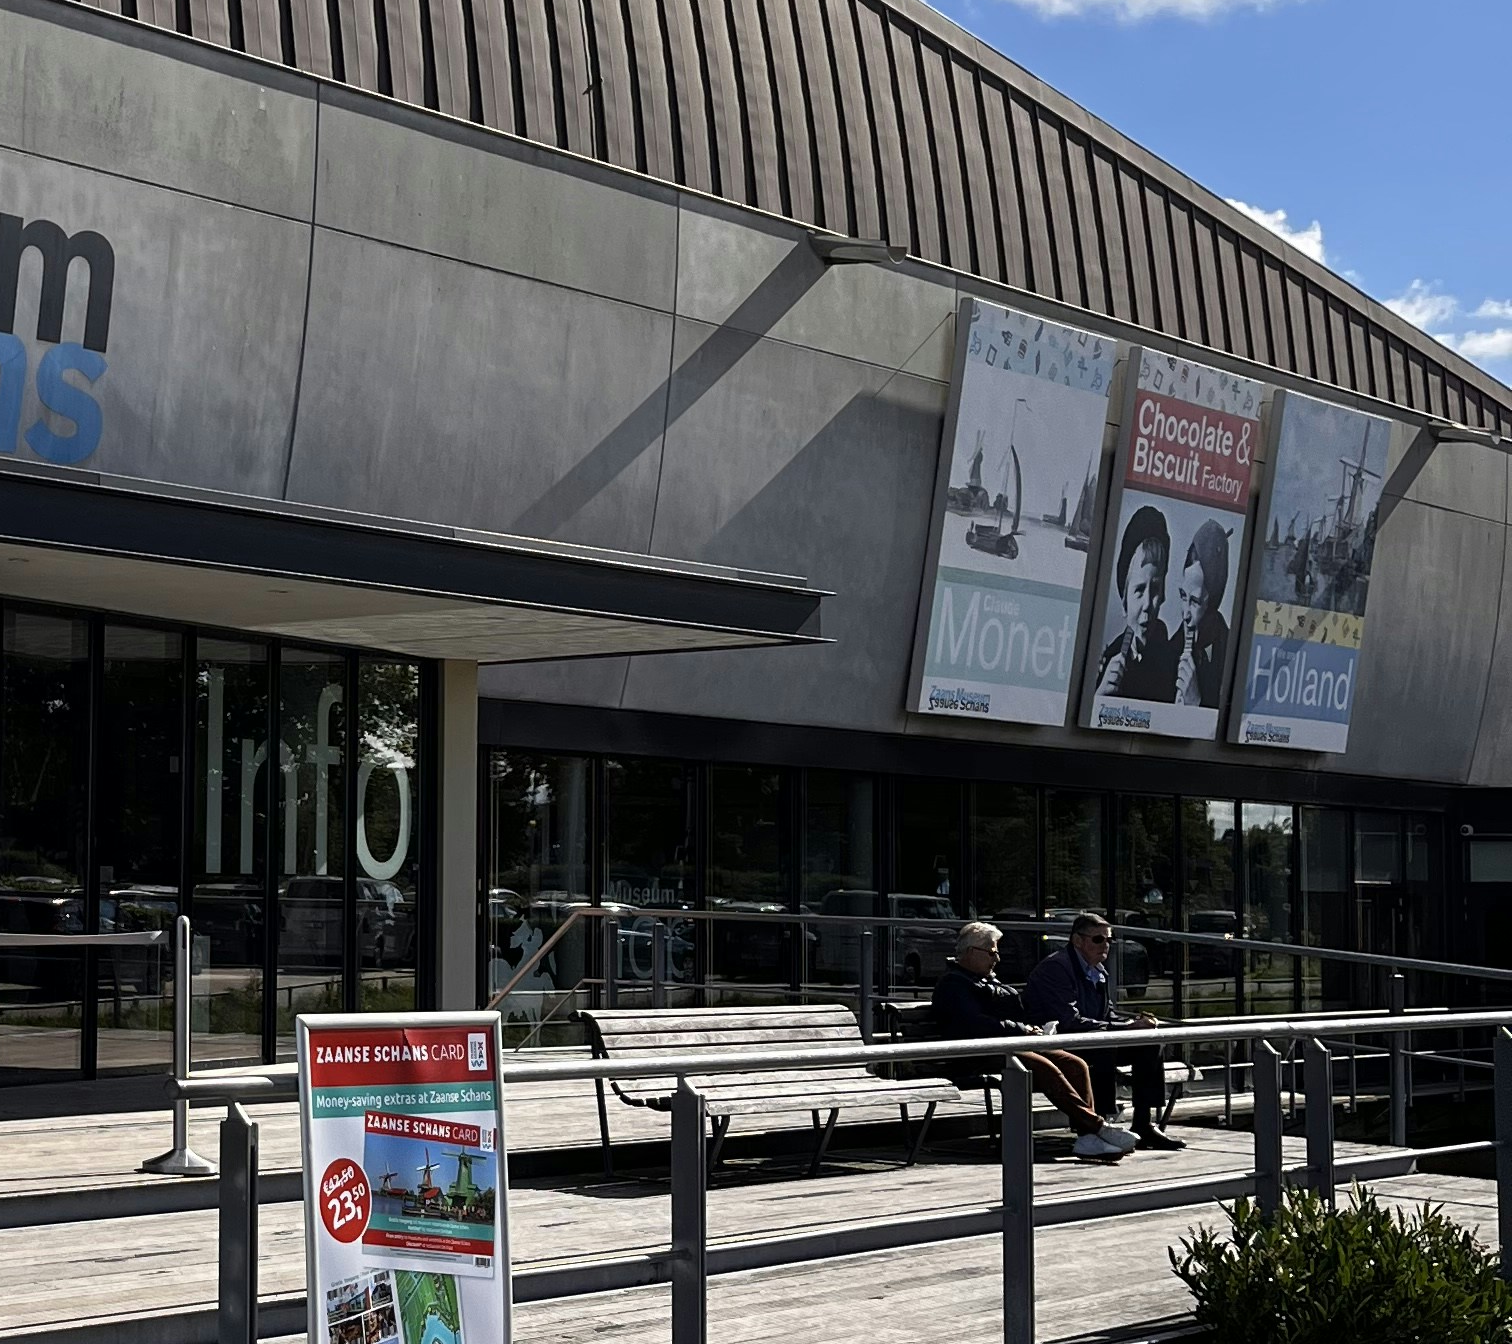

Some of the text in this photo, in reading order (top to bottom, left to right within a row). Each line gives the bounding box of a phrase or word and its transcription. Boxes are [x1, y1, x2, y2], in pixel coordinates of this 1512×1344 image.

[1139, 399, 1251, 467] Chocolate &
[1133, 437, 1244, 502] Biscuit Factory
[934, 587, 1071, 680] Monet
[1250, 645, 1354, 711] Holland
[205, 668, 412, 881] Info
[316, 1046, 370, 1064] ZAANSE
[374, 1044, 429, 1062] SCHANS
[431, 1044, 465, 1061] CARD
[316, 1088, 492, 1110] Money-saving extras at Zaanse Schans
[367, 1114, 410, 1133] ZAANSE
[413, 1122, 450, 1138] SCHANS
[452, 1126, 478, 1142] CARD
